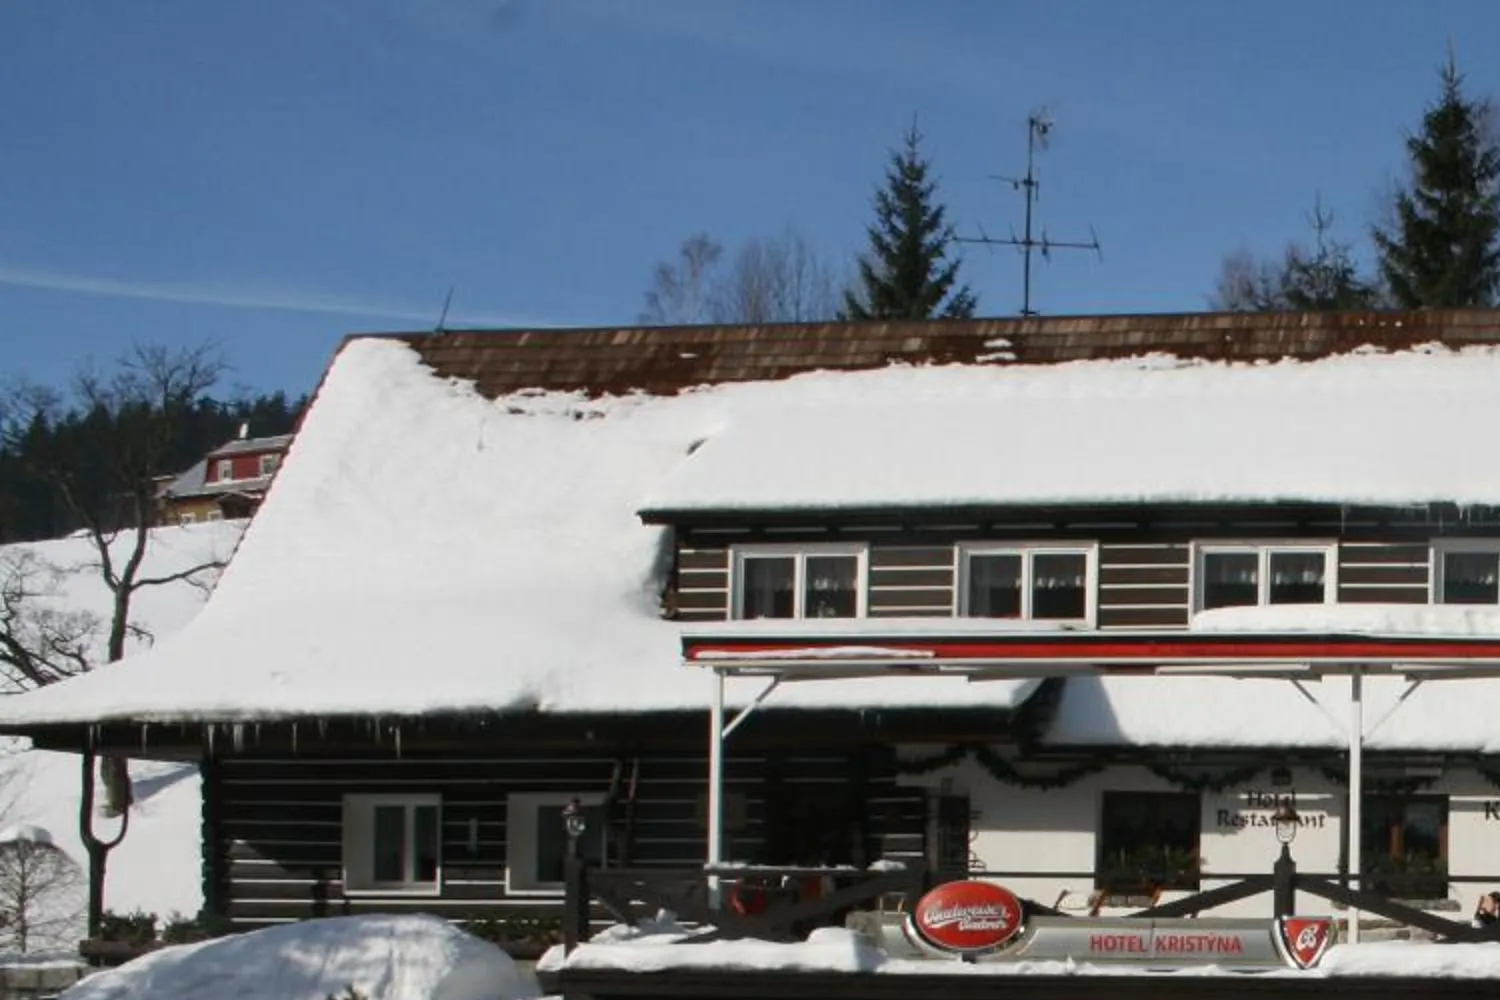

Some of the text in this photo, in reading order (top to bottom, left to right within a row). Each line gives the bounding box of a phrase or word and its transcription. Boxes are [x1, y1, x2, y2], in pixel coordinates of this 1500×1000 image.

[1247, 788, 1296, 808] Hotel
[1217, 809, 1325, 829] Restaant
[1090, 932, 1244, 954] HOTEL KRISTÝNA
